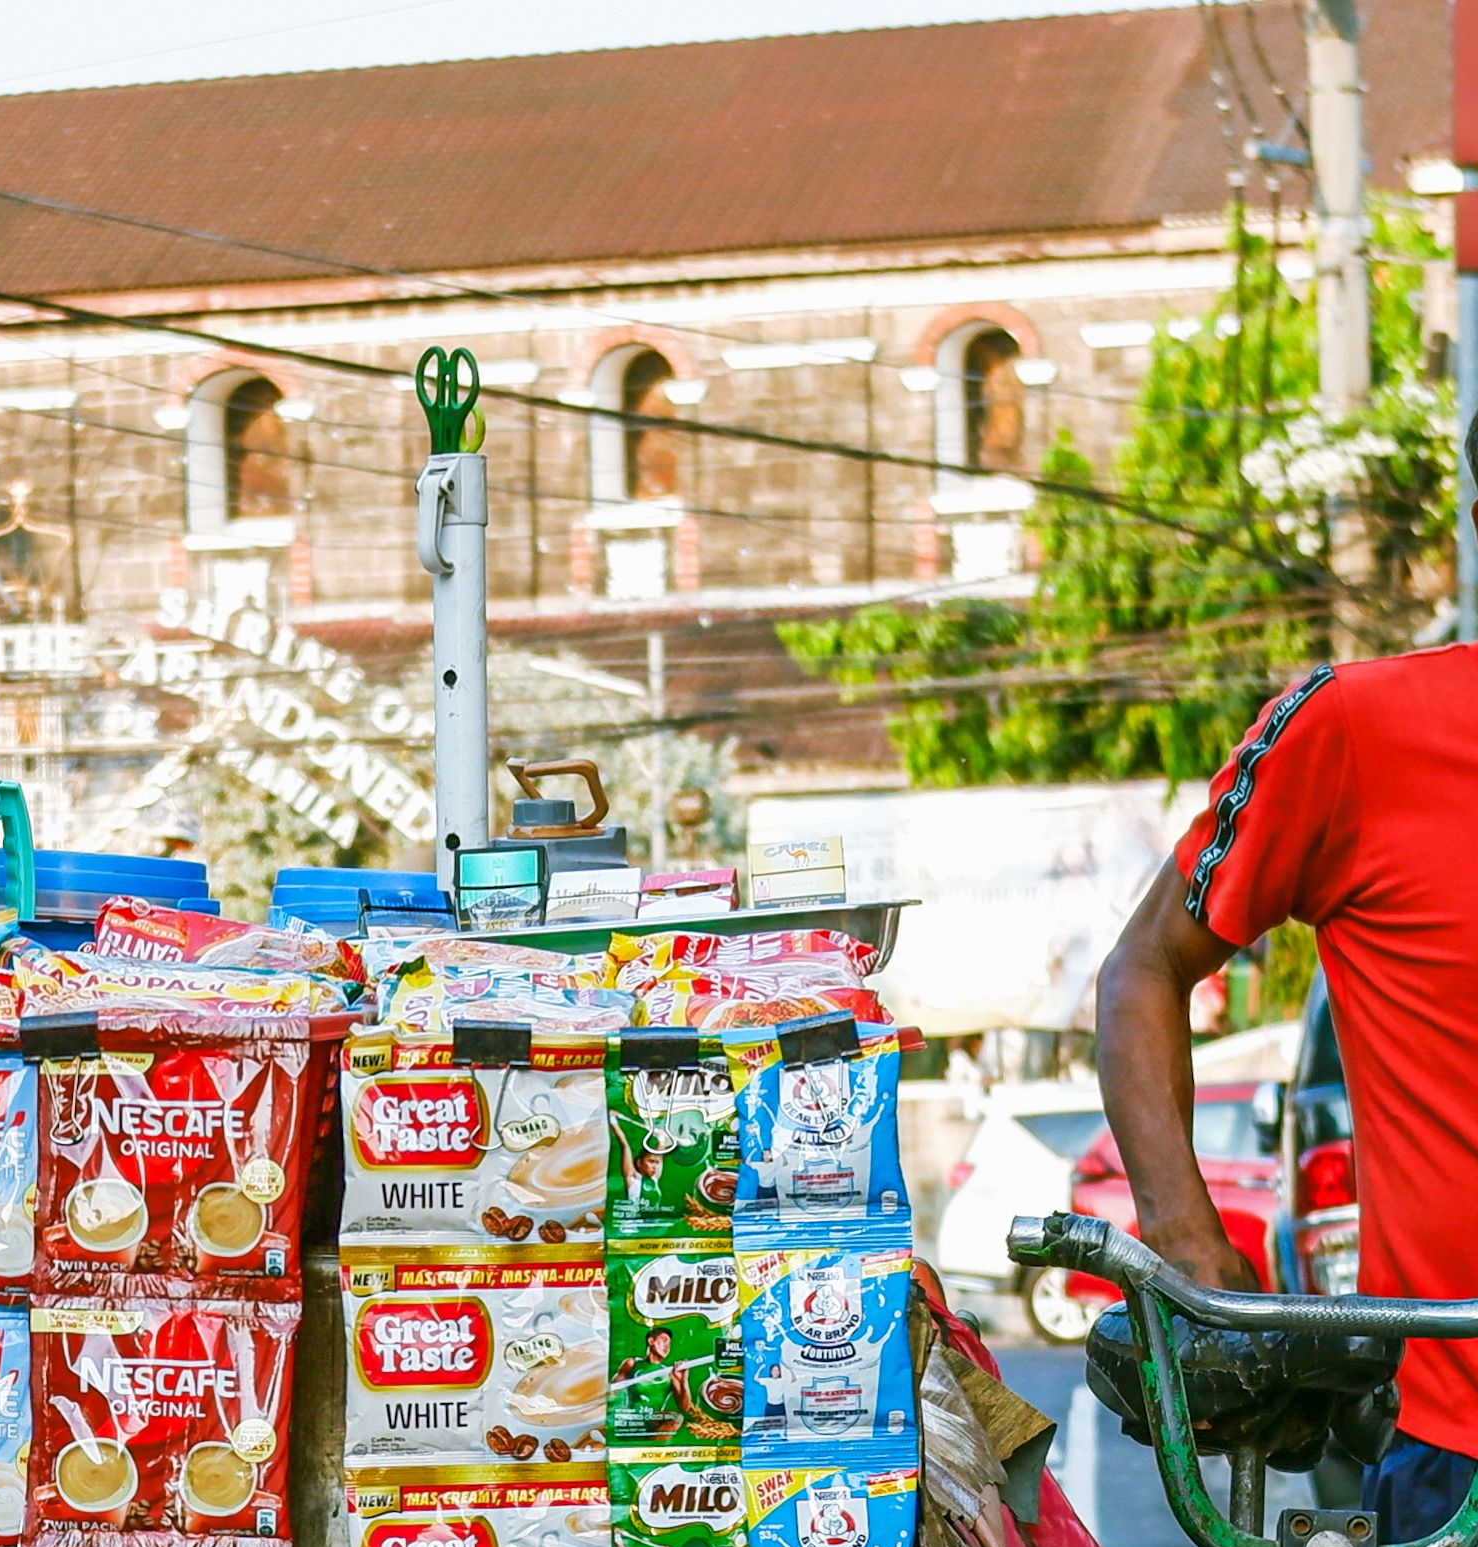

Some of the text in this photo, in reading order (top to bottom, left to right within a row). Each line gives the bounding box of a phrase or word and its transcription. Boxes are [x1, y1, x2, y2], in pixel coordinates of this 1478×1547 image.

[1272, 690, 1304, 726] PUMA
[763, 840, 830, 858] CAMEL
[1195, 848, 1222, 883] PUMA
[352, 1054, 385, 1067] NEW!
[373, 1093, 470, 1124] Great
[120, 1139, 214, 1159] ORIGINAL
[373, 1125, 471, 1152] Taste
[382, 1183, 464, 1209] WHITE
[401, 1271, 432, 1286] MAS
[502, 1270, 531, 1283] MAS
[646, 1275, 735, 1304] MILO
[374, 1315, 476, 1344] Great
[376, 1343, 475, 1372] Taste
[111, 1399, 206, 1419] ORIGINAL
[386, 1402, 468, 1429] WHITE
[756, 1470, 795, 1498] SWAK
[649, 1483, 740, 1513] MILO
[759, 1488, 785, 1511] PACK
